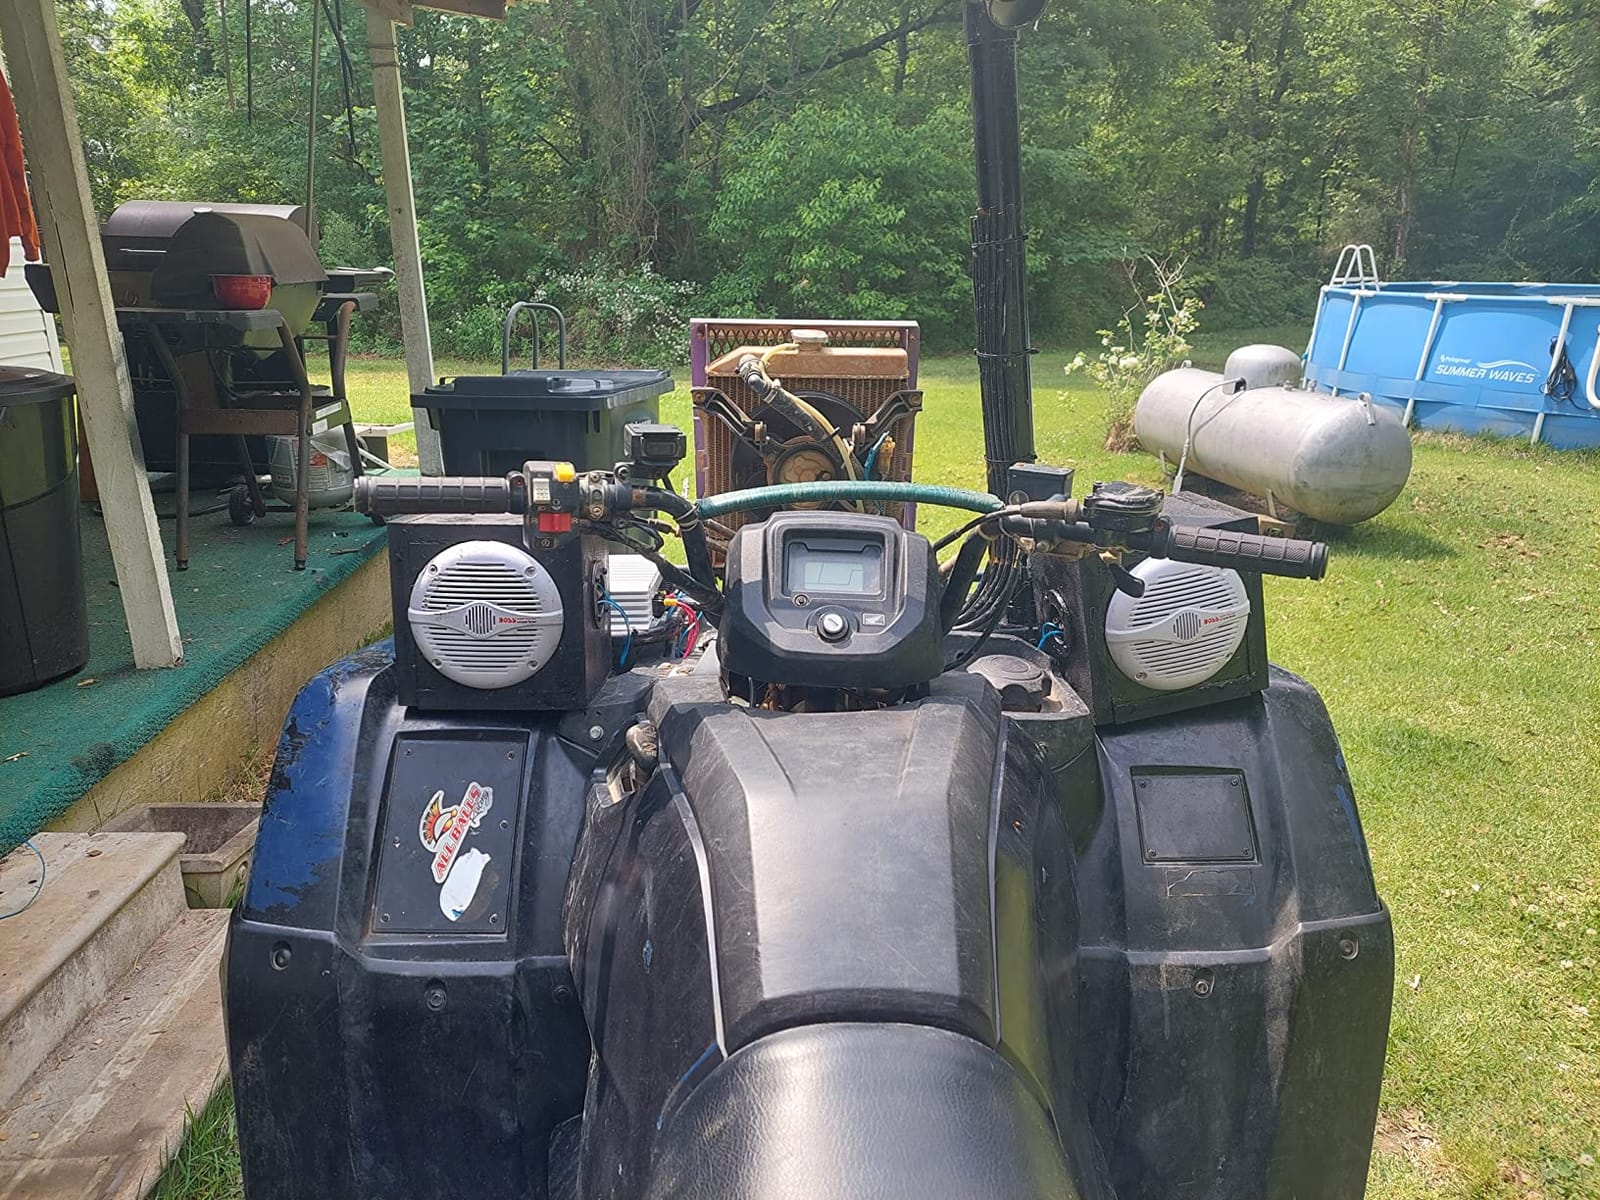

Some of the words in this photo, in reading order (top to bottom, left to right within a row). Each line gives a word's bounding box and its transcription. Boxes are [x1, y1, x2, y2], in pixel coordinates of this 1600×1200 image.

[1435, 365, 1486, 378] SUMMER
[1489, 370, 1536, 383] WAVES
[434, 841, 455, 877] ALL
[449, 785, 481, 841] BALLS
